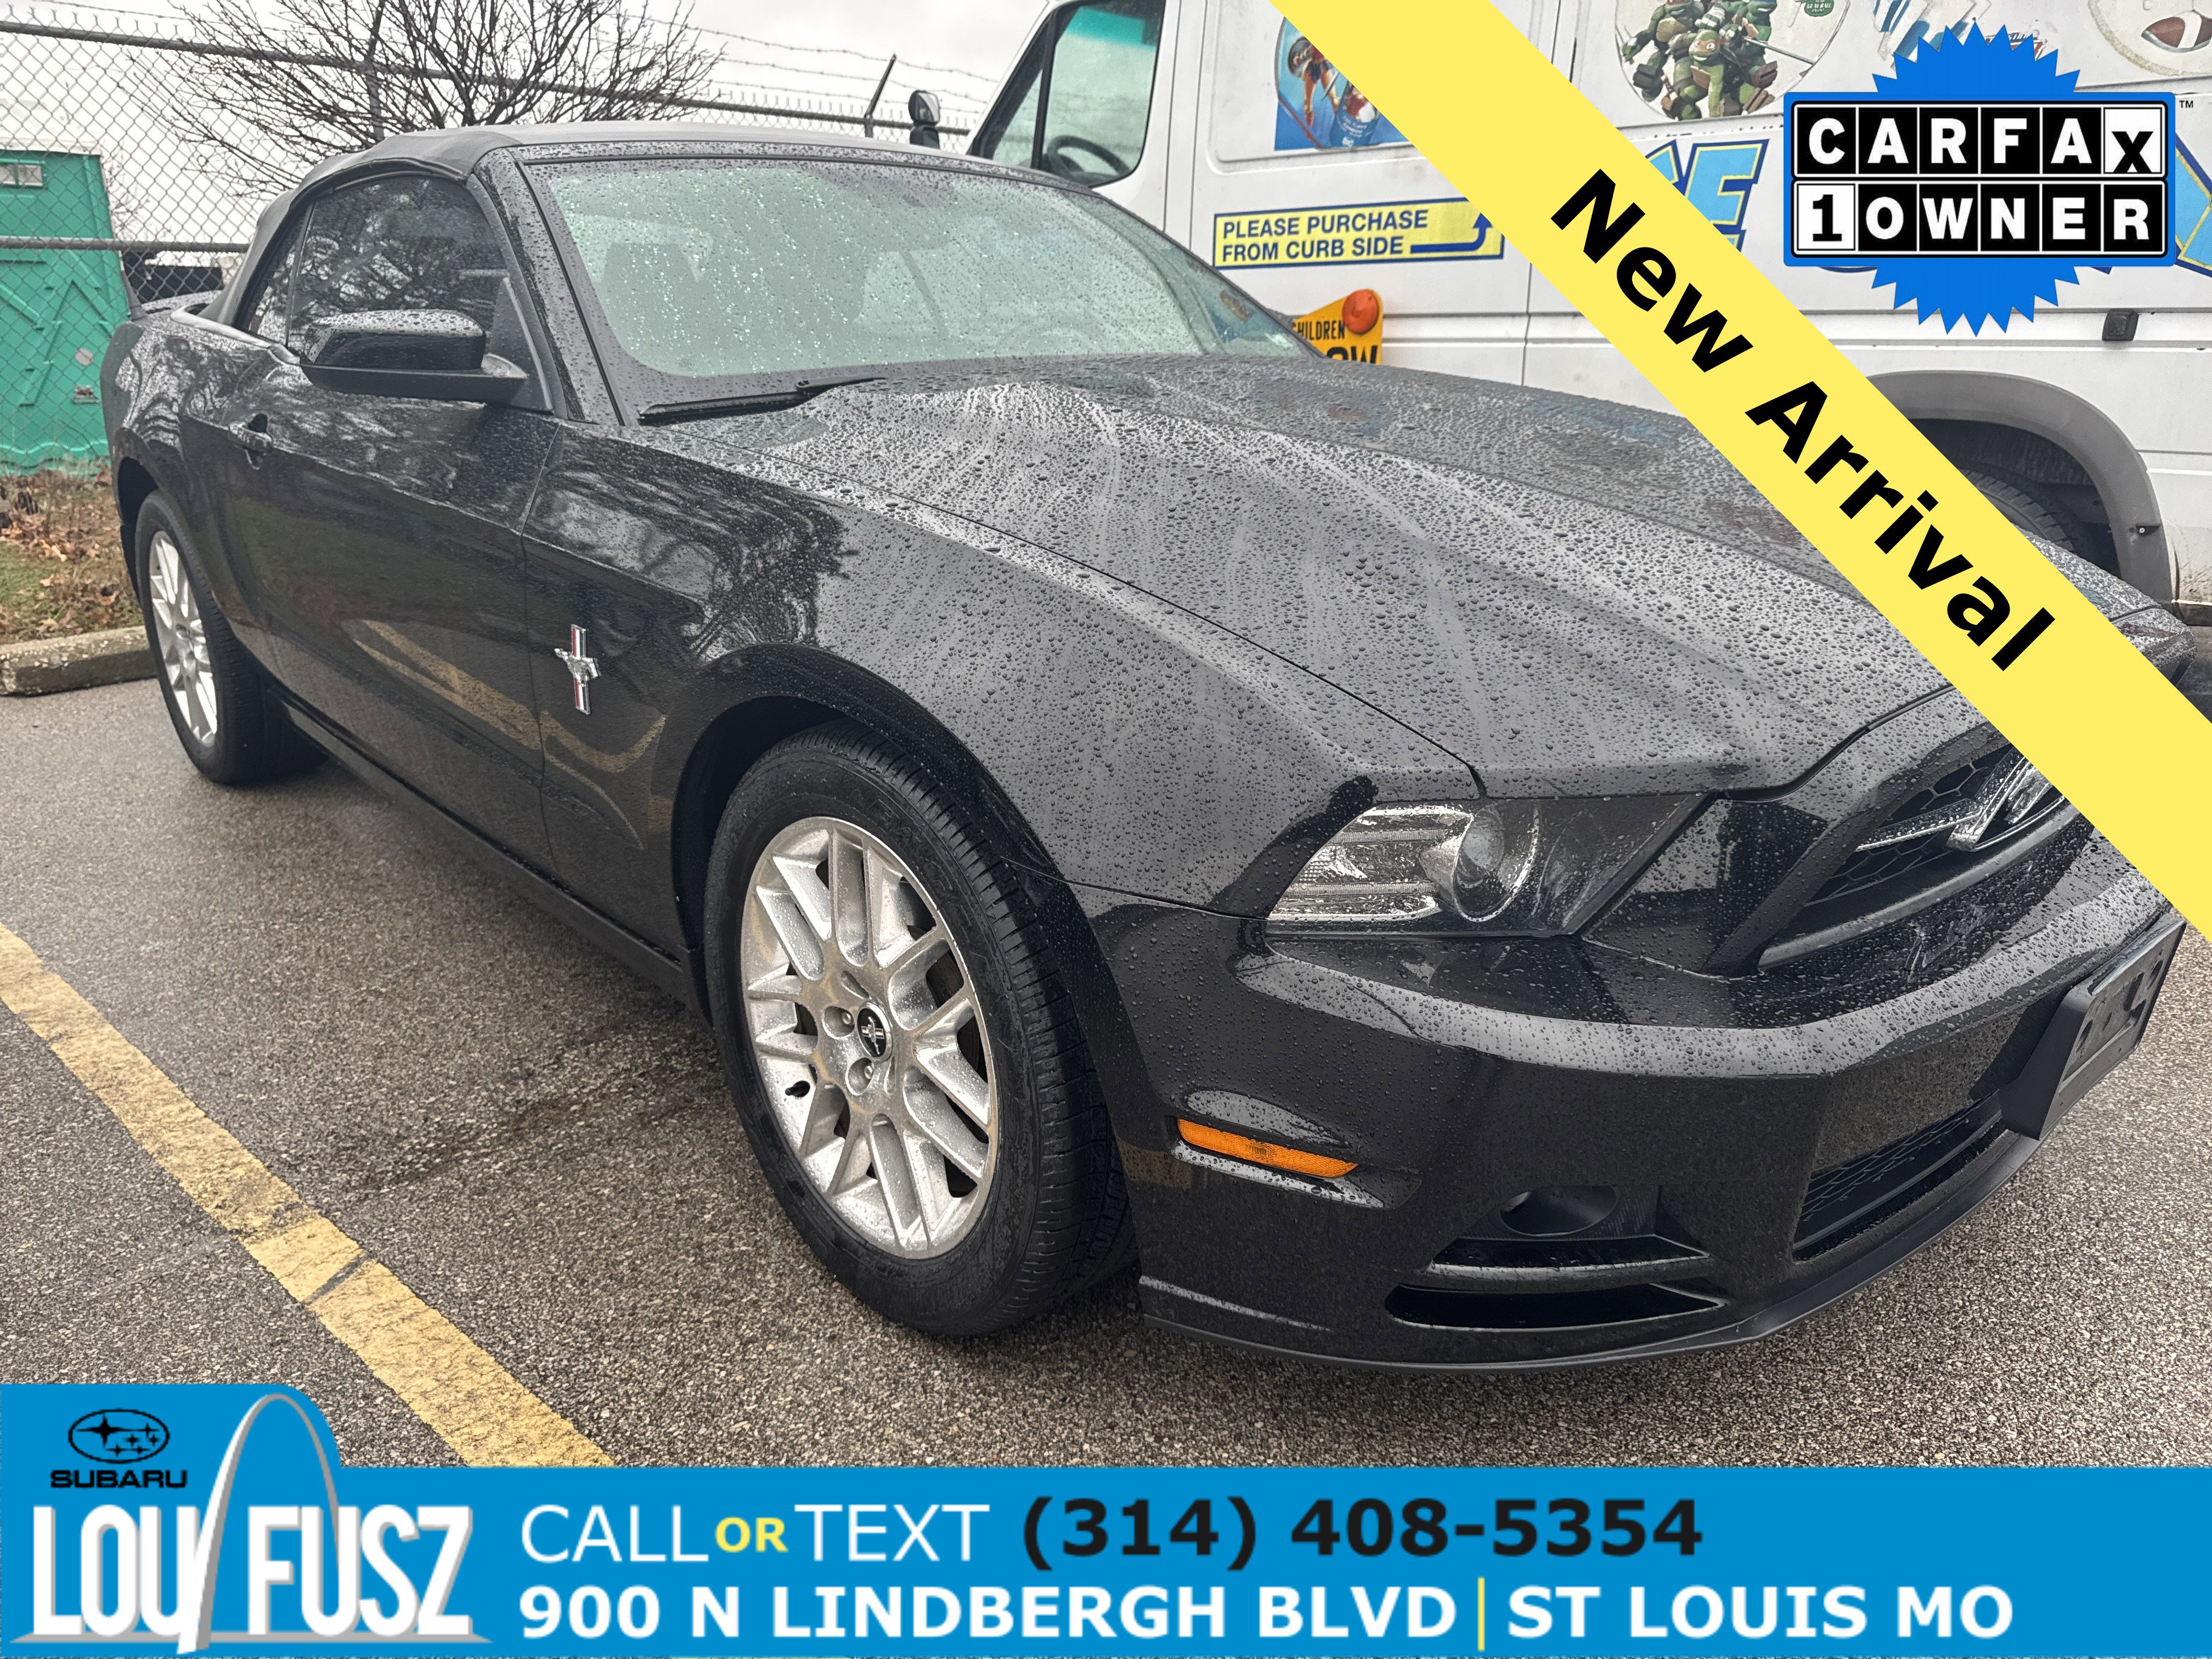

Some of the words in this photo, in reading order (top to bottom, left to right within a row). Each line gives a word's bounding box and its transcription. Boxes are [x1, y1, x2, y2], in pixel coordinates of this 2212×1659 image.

[1223, 217, 1300, 239] PLEASE
[1307, 209, 1429, 235] PURCHASE
[1222, 242, 1279, 262] FROM
[1286, 239, 1345, 259] CURB
[1351, 236, 1404, 257] SIDE
